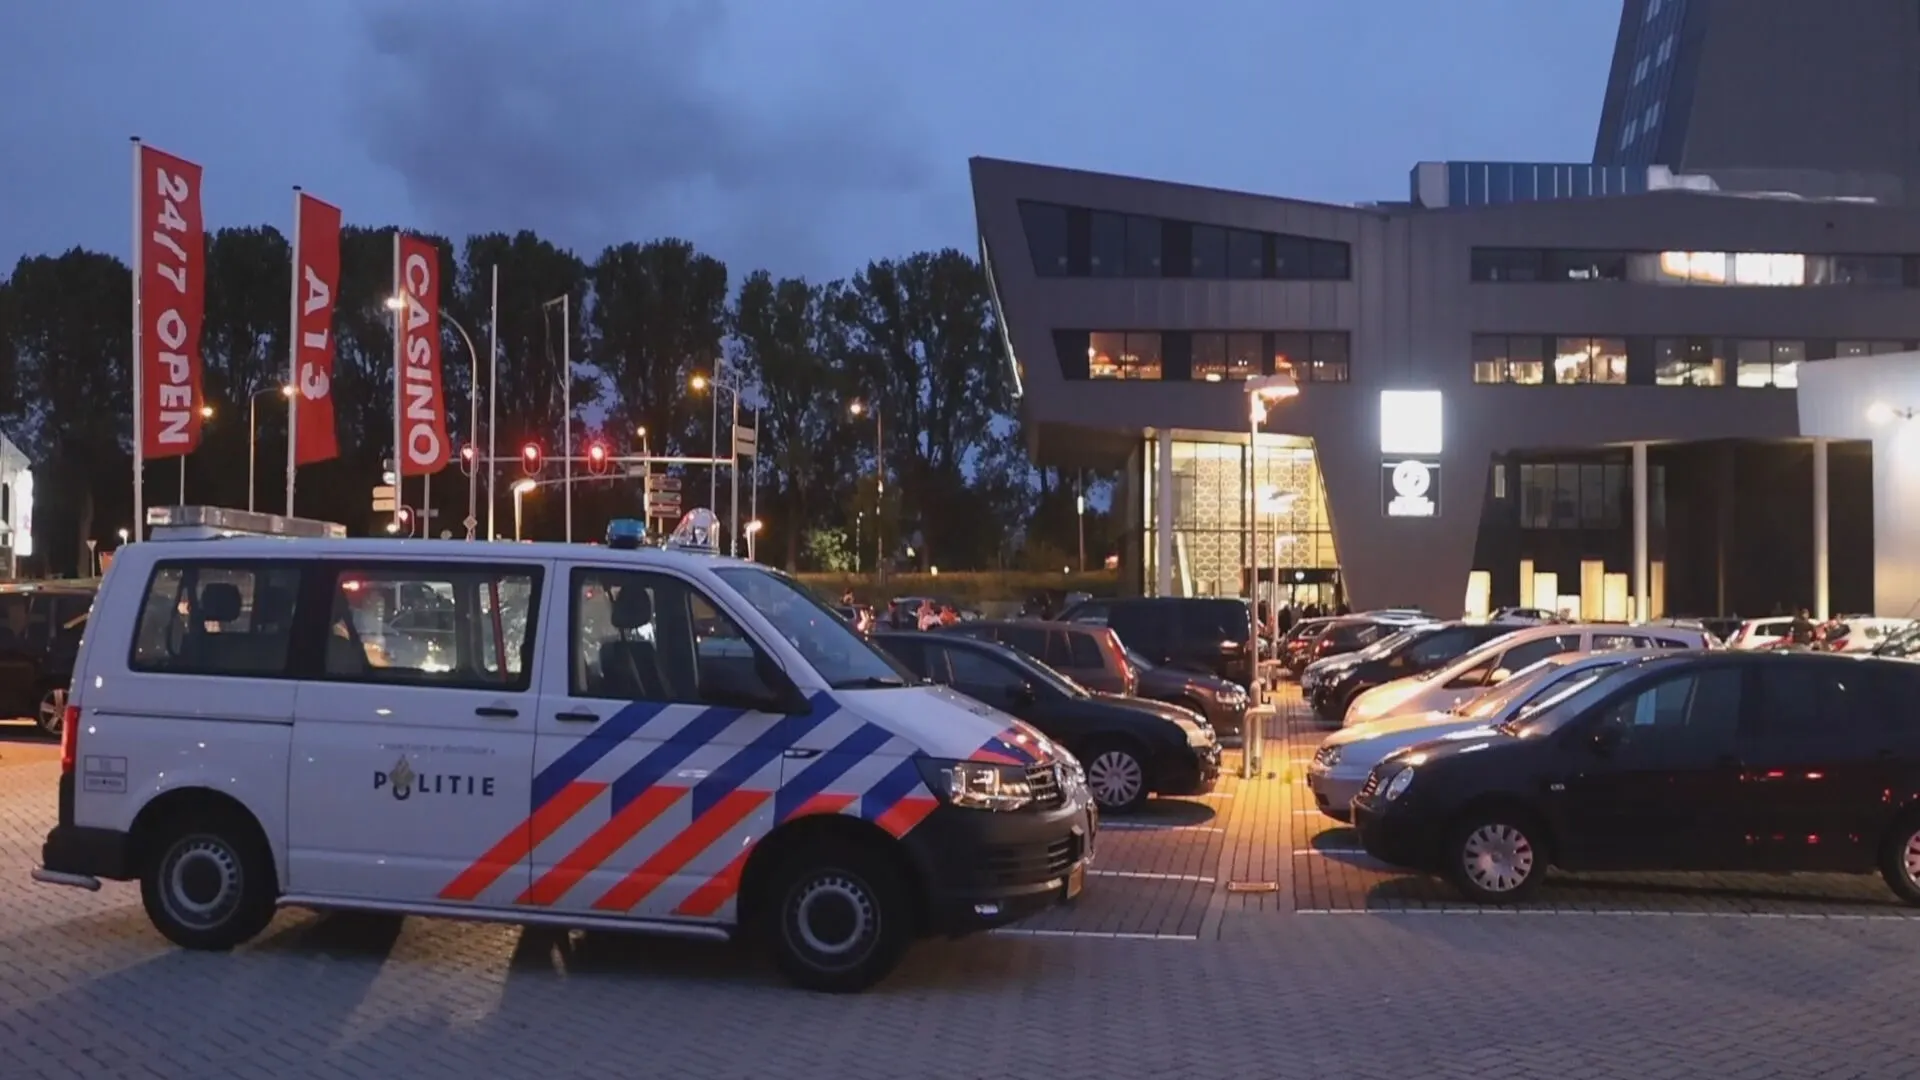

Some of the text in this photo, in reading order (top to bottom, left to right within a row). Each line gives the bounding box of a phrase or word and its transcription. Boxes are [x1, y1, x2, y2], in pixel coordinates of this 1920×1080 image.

[153, 167, 192, 444] 24/7 OPEN
[405, 253, 440, 466] CASINO
[373, 770, 495, 801] POLITIE
